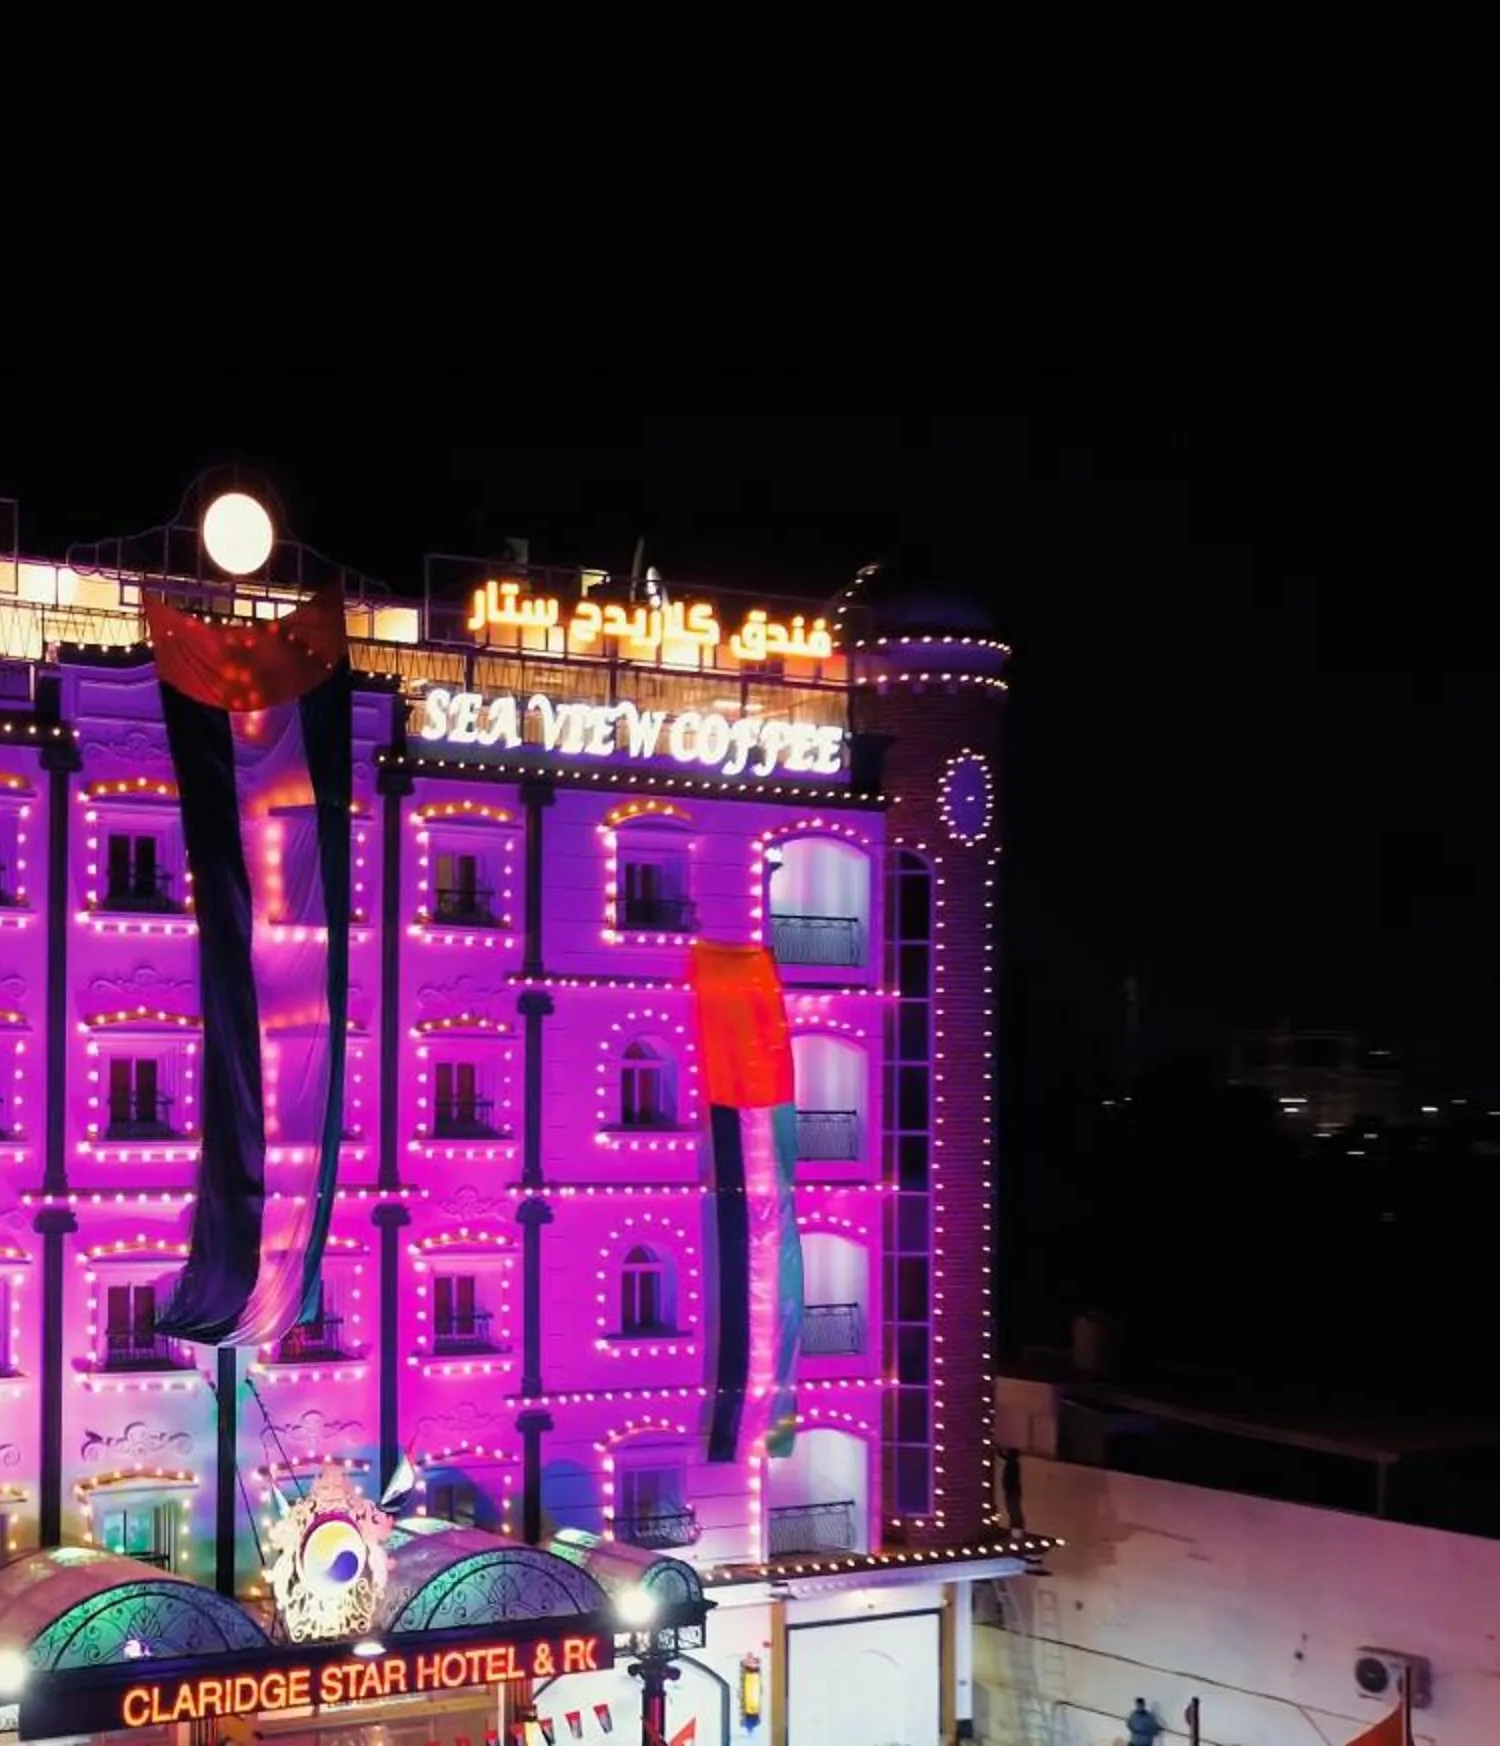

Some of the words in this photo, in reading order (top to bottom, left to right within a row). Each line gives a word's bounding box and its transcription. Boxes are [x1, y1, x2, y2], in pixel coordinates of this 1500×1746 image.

[467, 580, 559, 630] ستار
[728, 609, 833, 660] فندق
[421, 688, 522, 748] SEA
[527, 693, 666, 759] VIEW
[669, 711, 844, 777] COFFEE
[122, 1670, 311, 1727] CLARIDGE
[319, 1658, 405, 1701] STAR
[417, 1647, 524, 1689] HOTEL
[533, 1643, 555, 1675] &
